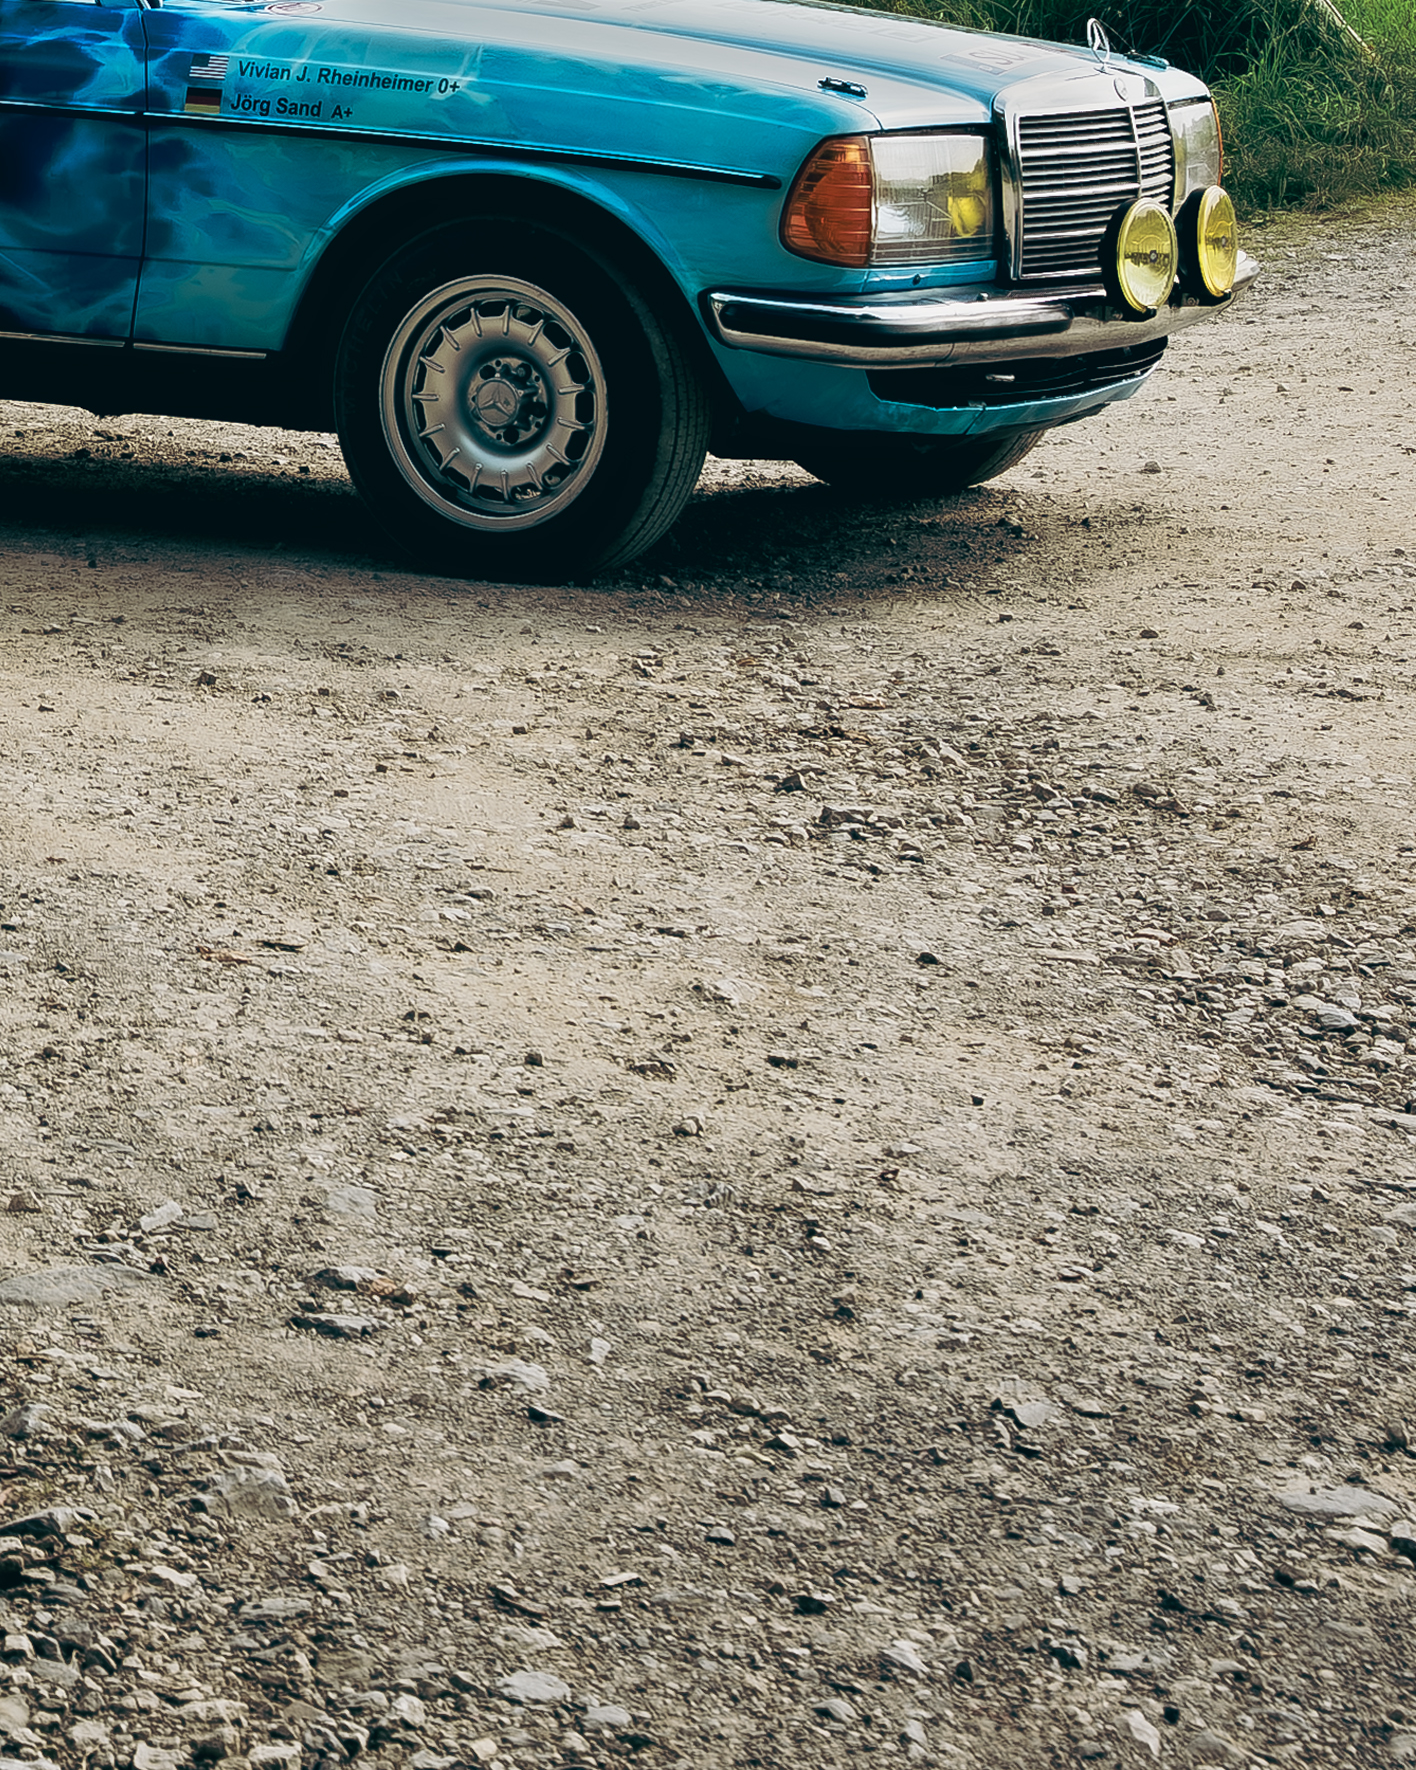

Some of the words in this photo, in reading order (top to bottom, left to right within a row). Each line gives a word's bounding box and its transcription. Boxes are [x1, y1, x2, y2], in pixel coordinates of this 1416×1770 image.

[238, 60, 291, 81] Vivian
[296, 65, 311, 83] J.
[317, 67, 434, 94] Rheinheimer
[230, 93, 271, 117] Jörg
[276, 97, 322, 118] Sand
[330, 105, 354, 120] A+
